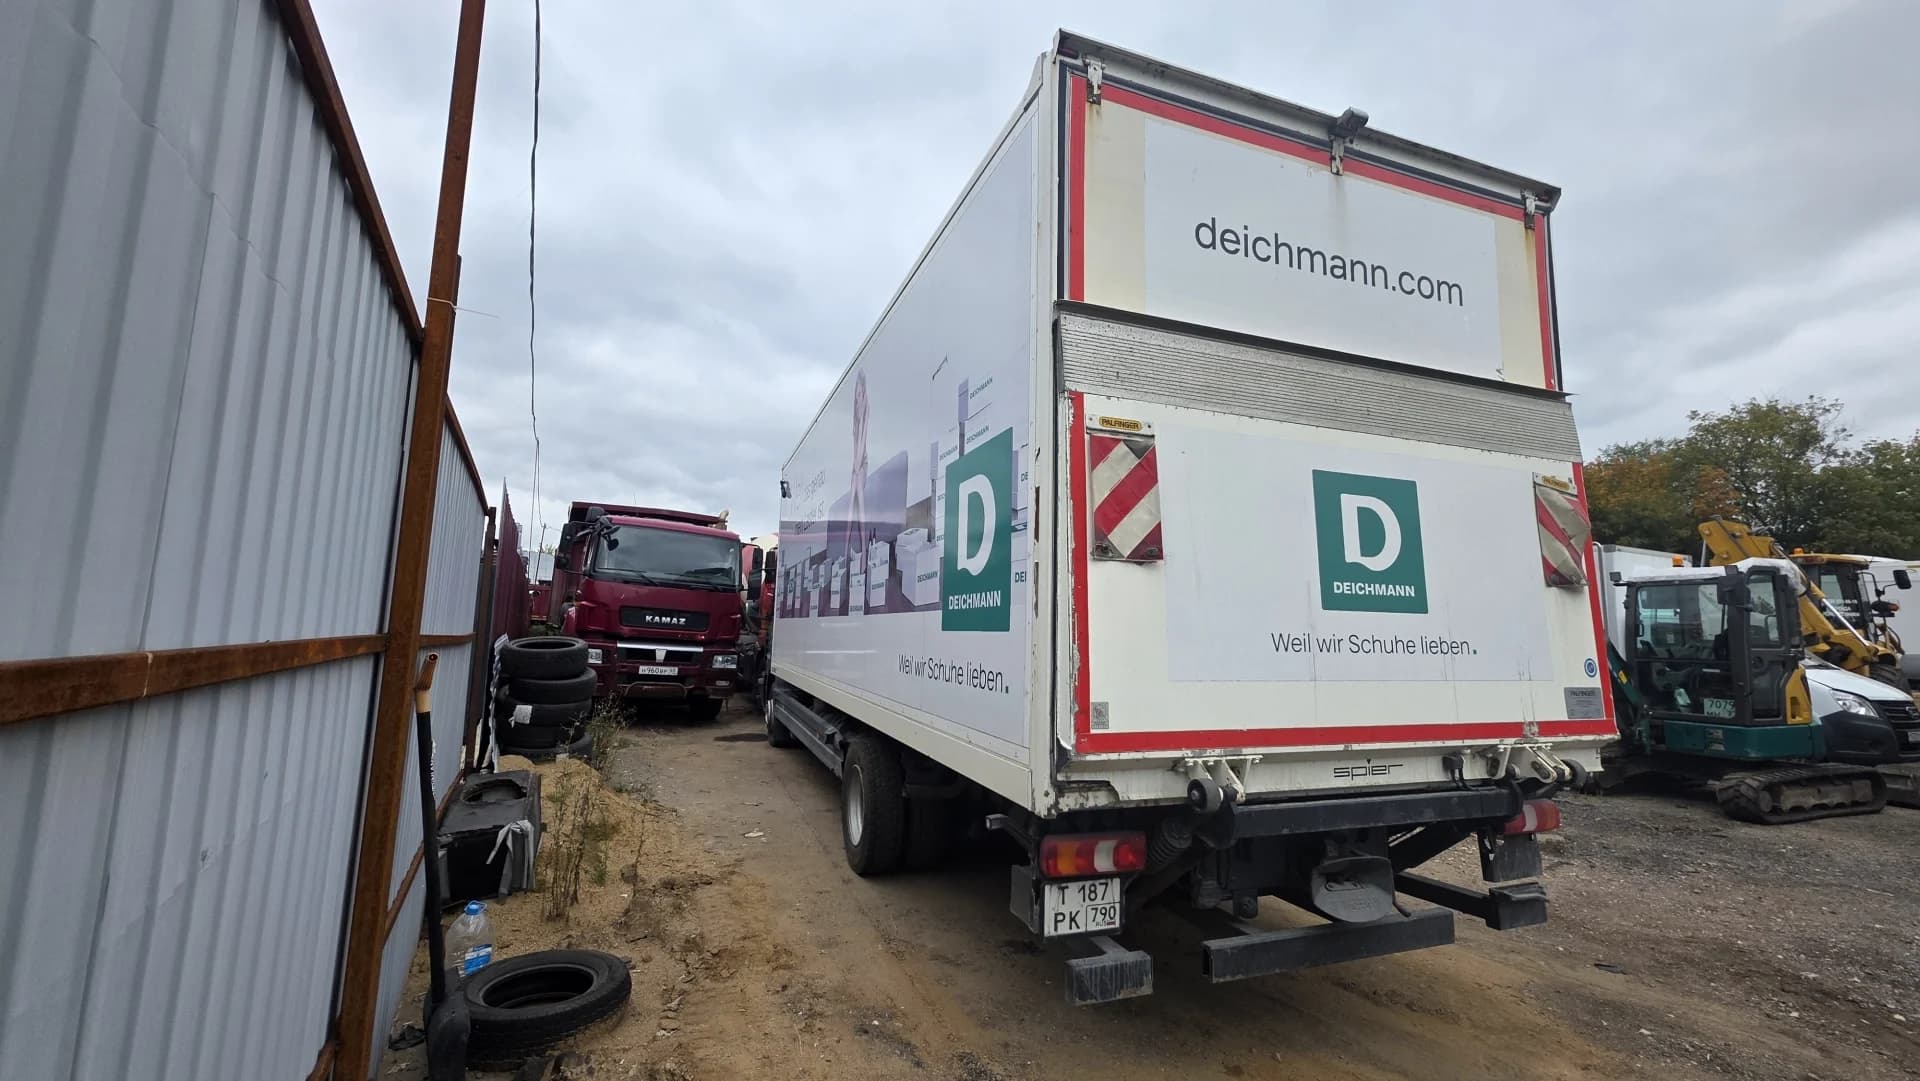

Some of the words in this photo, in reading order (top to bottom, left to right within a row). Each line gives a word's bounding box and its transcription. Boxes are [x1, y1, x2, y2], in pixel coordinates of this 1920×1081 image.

[1195, 217, 1464, 307] deichmann.com
[1101, 418, 1139, 429] PALFINGER
[957, 473, 996, 576] D
[1340, 493, 1402, 571] D
[948, 589, 1001, 610] DEICHMANN
[1333, 581, 1415, 597] DEICHMANN
[645, 615, 687, 625] KAMAZ
[1271, 632, 1311, 653] Weil
[1316, 633, 1344, 653] wir
[1348, 634, 1416, 655] Schuhe
[1420, 635, 1478, 655] lieben.
[898, 653, 914, 676] Weil
[914, 656, 927, 678] wir
[927, 657, 964, 685] Schuhe
[1333, 758, 1403, 781] spier
[1078, 882, 1108, 903] 187
[1091, 906, 1117, 922] 790
